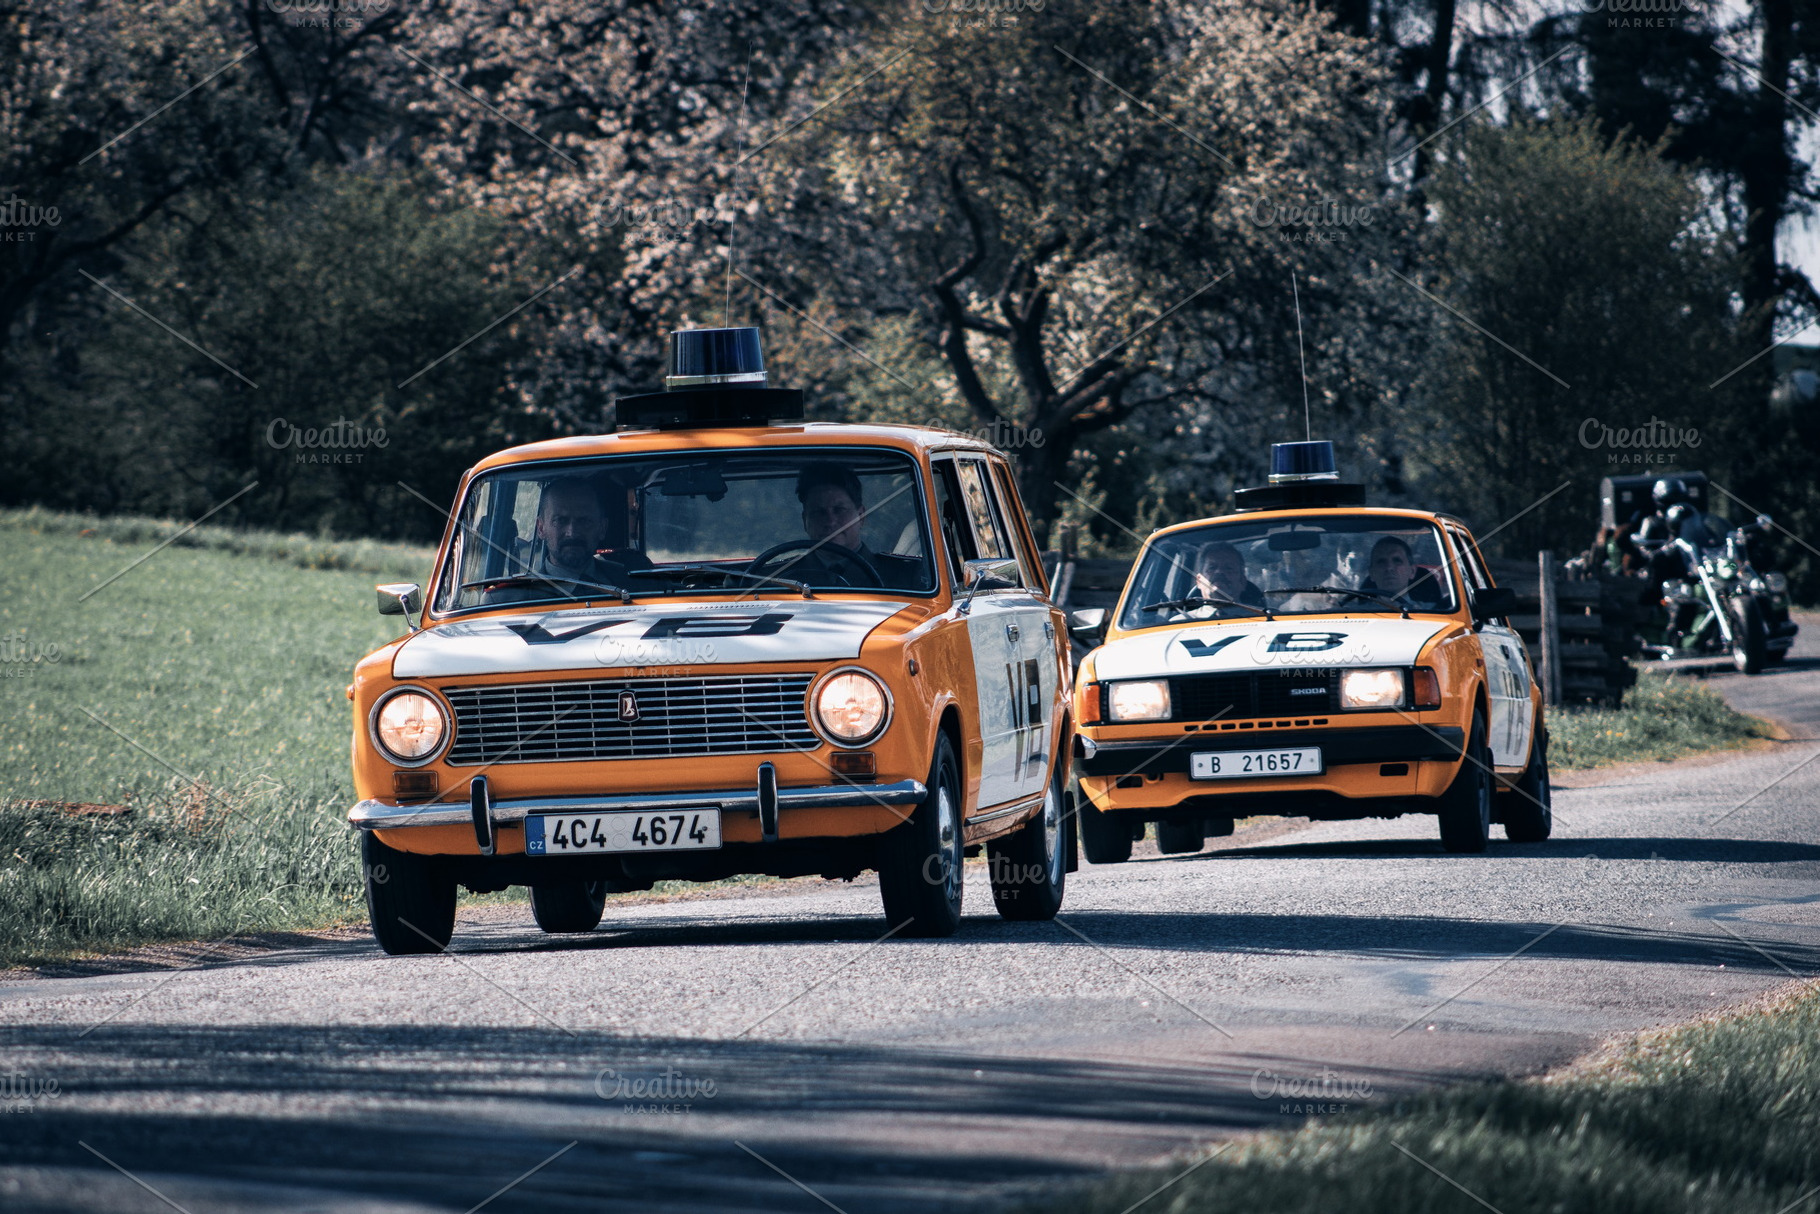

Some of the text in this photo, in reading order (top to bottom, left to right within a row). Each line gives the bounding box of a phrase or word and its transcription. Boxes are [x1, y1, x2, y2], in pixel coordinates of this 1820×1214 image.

[1211, 752, 1303, 773] B 21657
[552, 814, 706, 849] 4C4 4674
[529, 841, 544, 850] CZ
